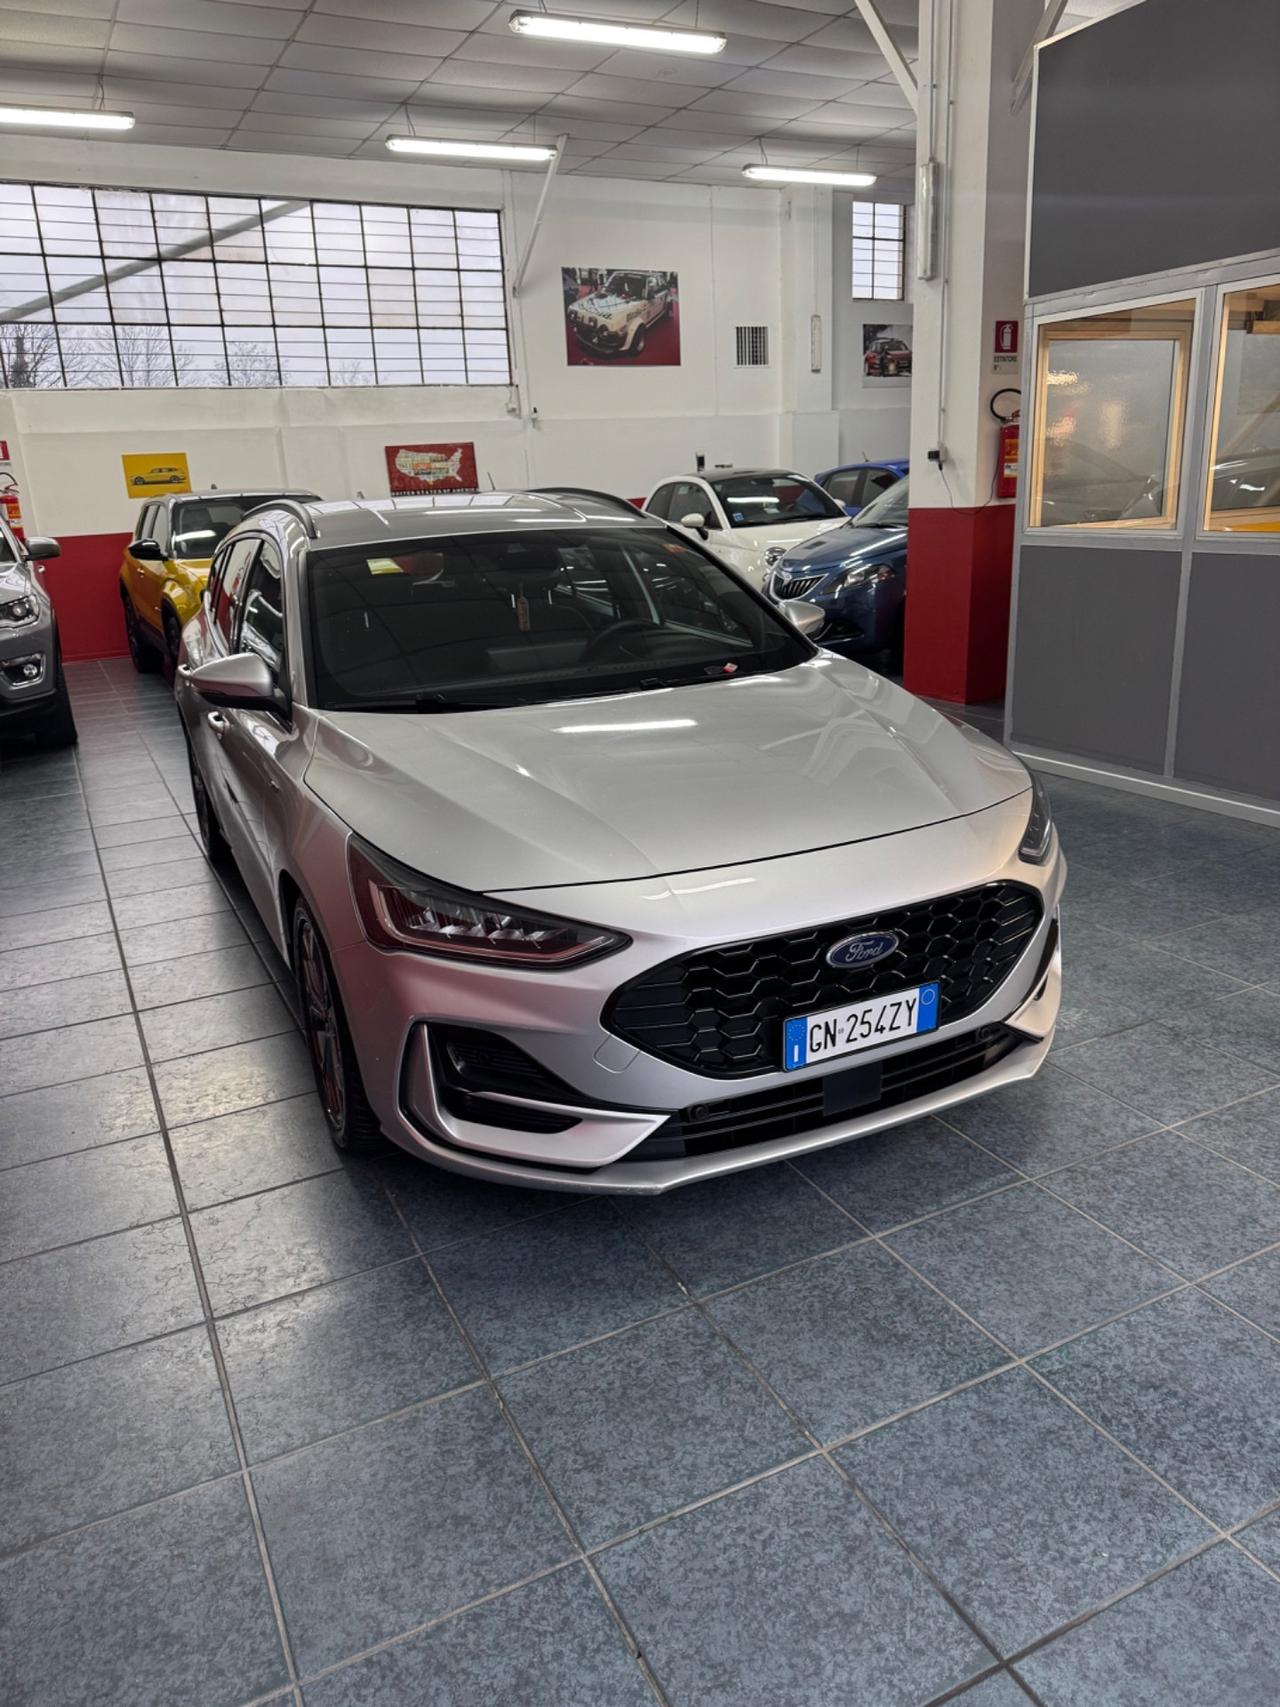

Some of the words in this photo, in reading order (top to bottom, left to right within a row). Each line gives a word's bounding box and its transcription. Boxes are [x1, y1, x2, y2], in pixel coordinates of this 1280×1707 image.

[845, 940, 884, 962] Ford
[809, 1019, 837, 1053] GN
[845, 998, 917, 1043] 254ZY
